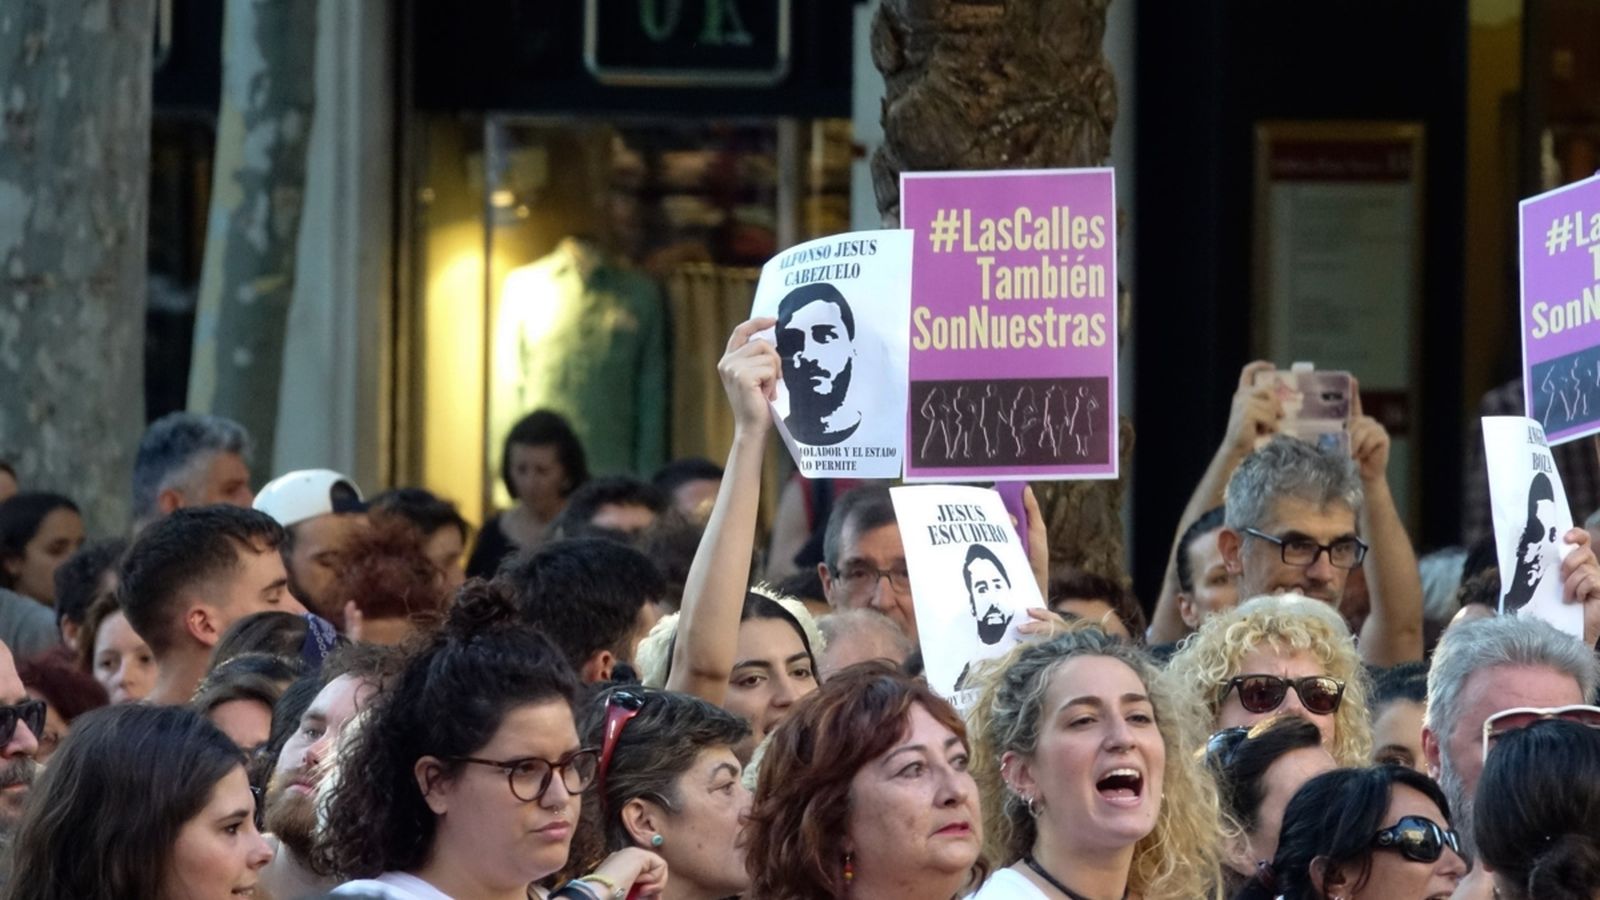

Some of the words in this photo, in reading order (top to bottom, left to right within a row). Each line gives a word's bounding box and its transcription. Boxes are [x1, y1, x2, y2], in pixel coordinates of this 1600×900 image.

[929, 206, 1106, 253] #LasCalles
[834, 239, 878, 258] JESUS
[784, 262, 861, 287] CABEZUELO
[976, 255, 1105, 300] También
[913, 305, 1106, 351] SonNuestras
[843, 446, 850, 458] Y
[852, 446, 864, 458] EL
[865, 446, 897, 458] ESTADO
[1532, 452, 1553, 473] BOZA
[815, 460, 857, 471] PERMITE
[937, 504, 986, 522] JESUS
[927, 523, 1009, 545] ESCUDERO
